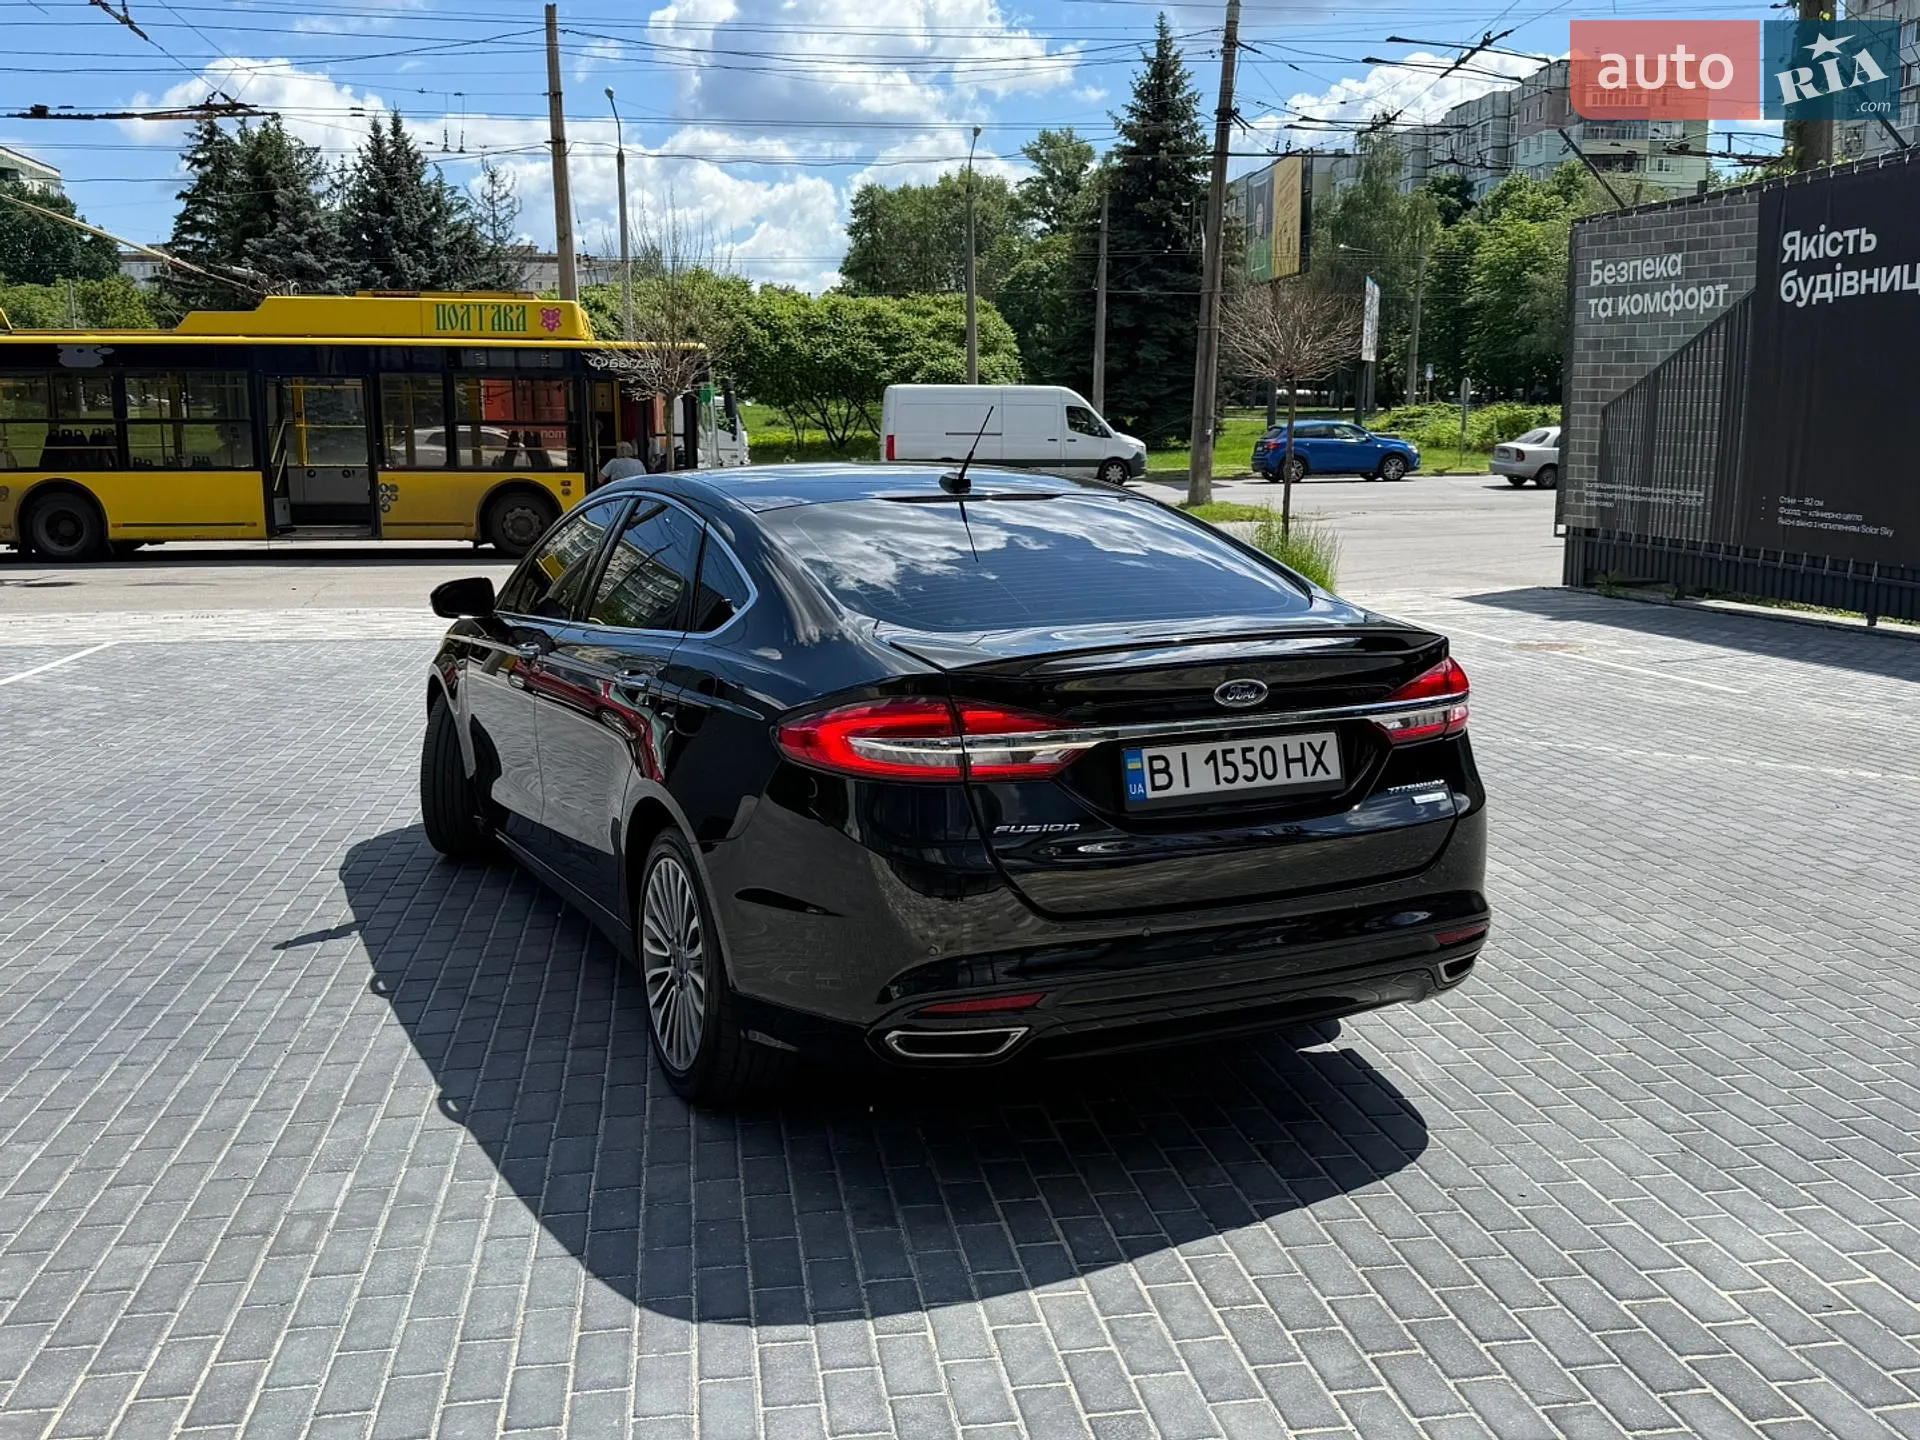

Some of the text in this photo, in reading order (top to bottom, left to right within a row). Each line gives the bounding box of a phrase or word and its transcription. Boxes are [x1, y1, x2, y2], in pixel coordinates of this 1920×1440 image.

[1781, 224, 1877, 263] Якість
[1590, 253, 1682, 287] Безпека
[435, 303, 528, 332] ПОЛТАВА
[1588, 283, 1729, 319] та комфорт
[1147, 740, 1331, 792] BI 1550 HX
[1129, 783, 1145, 795] UA
[993, 823, 1081, 834] FUSION
